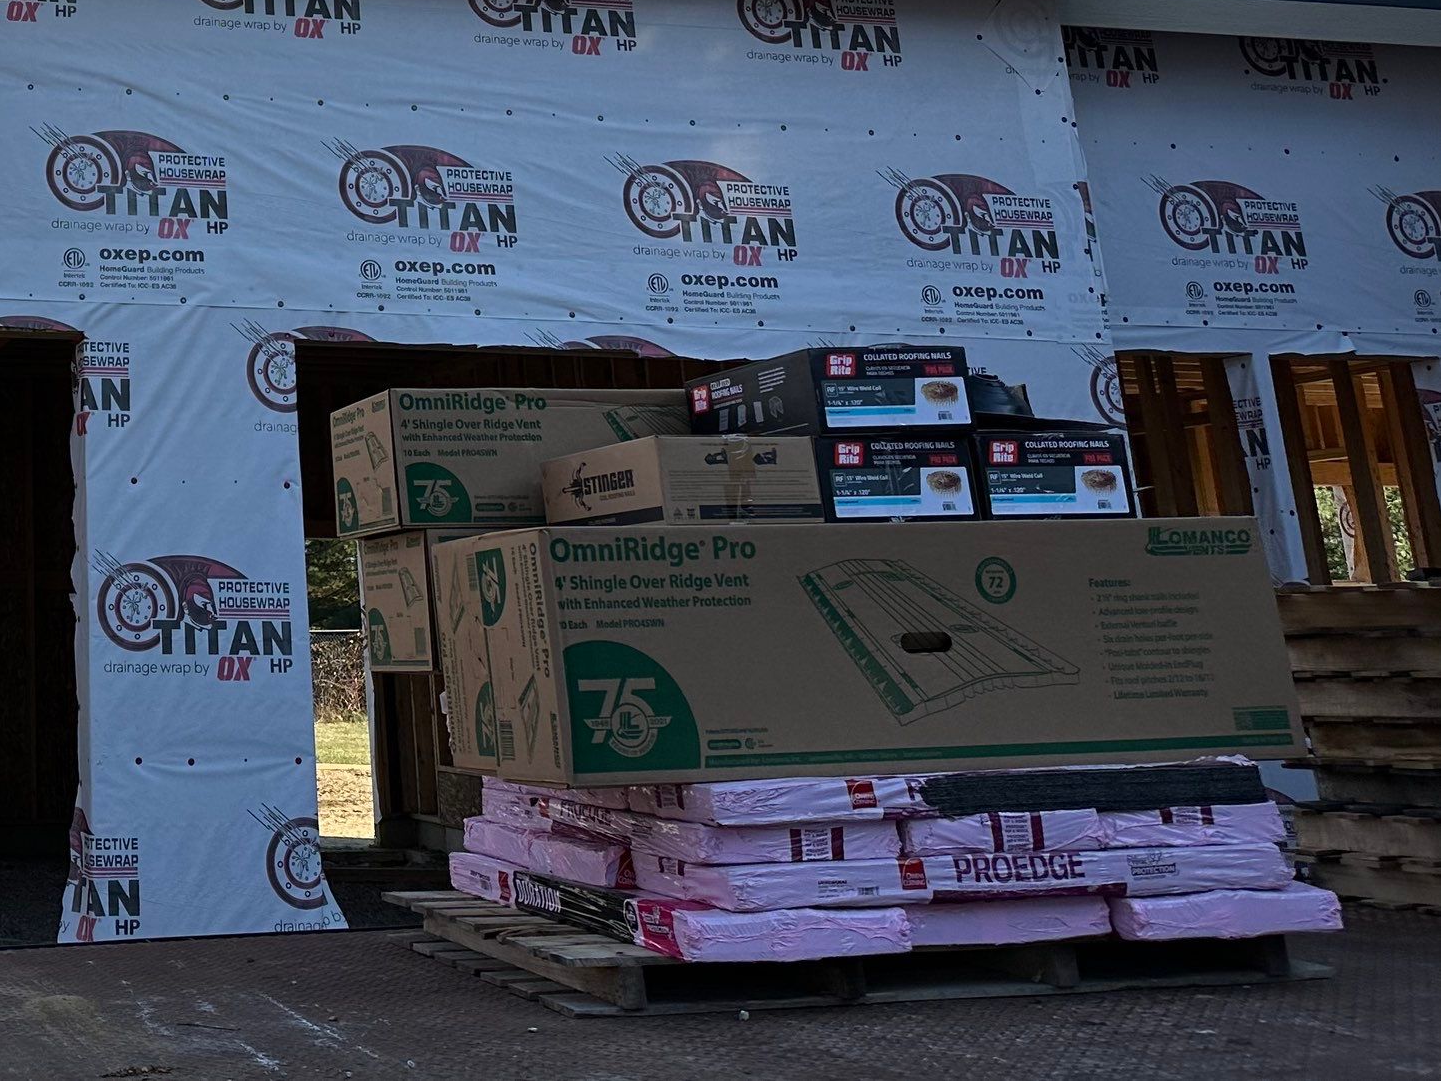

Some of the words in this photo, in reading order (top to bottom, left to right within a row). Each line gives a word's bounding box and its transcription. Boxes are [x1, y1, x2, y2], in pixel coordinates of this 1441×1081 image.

[6, 1, 40, 22] OX
[56, 4, 77, 18] HP
[515, 5, 635, 37] TITAN
[572, 35, 601, 56] OX
[617, 39, 636, 52] HP
[1283, 54, 1378, 84] TITAN
[726, 183, 789, 196] PROTECTIVE
[728, 196, 792, 209] HOUSEWRAP
[389, 200, 517, 233] TITAN
[673, 213, 797, 247] TITAN
[1203, 227, 1307, 257] TITAN
[733, 245, 763, 266] OX
[777, 248, 798, 262] HP
[394, 258, 496, 276] oxep.com
[681, 272, 779, 290] oxep.com
[1213, 279, 1295, 295] oxep.com
[830, 356, 852, 366] Grip
[831, 366, 851, 375] Rite
[399, 393, 507, 414] OmniRidge
[515, 393, 547, 410] Pro
[413, 419, 453, 431] Shingle
[455, 420, 480, 429] Over
[484, 420, 514, 431] Ridge
[516, 420, 541, 429] Vent
[414, 449, 430, 457] Each
[993, 443, 1014, 453] Grip
[993, 453, 1013, 462] Rite
[584, 469, 634, 495] STINGER
[1148, 527, 1251, 545] LOMANCO
[550, 536, 700, 567] OmniRidge
[712, 536, 756, 560] Pro
[218, 581, 290, 595] PROTECTIVE
[570, 575, 627, 592] Shingle
[630, 575, 666, 589] Over
[670, 573, 712, 591] Ridge
[714, 573, 749, 588] Vent
[989, 577, 1003, 588] 72
[1089, 578, 1131, 588] Features:
[219, 596, 290, 610] HOUSEWRAP
[557, 597, 582, 610] with
[585, 596, 640, 609] Enhanced
[642, 595, 690, 608] Weather
[693, 595, 751, 607] Protection
[151, 619, 292, 656] TITAN
[104, 660, 158, 676] drainage
[161, 662, 192, 676] wrap
[195, 661, 209, 678] by
[217, 657, 251, 681] OX
[271, 658, 293, 673] HP
[578, 677, 656, 744] 75
[952, 853, 1086, 883] PROEDGE
